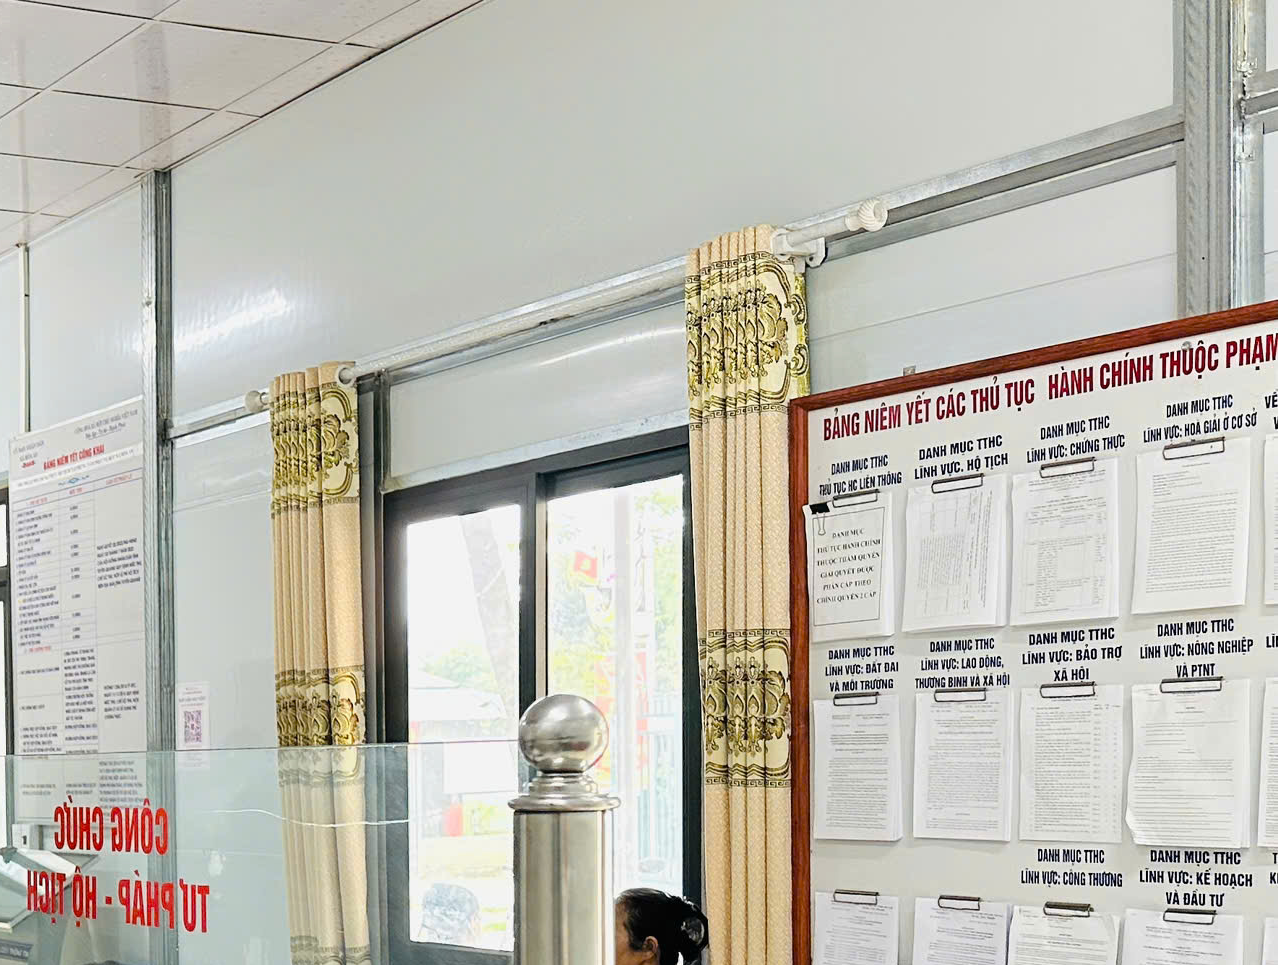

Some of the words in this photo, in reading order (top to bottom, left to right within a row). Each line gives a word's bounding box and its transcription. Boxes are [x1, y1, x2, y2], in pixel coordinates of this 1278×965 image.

[823, 408, 860, 441] BẢNG
[864, 402, 901, 433] NIÊM
[906, 391, 931, 426] YẾT
[936, 388, 966, 420] CÁC
[971, 376, 1000, 414] THỦ
[1005, 378, 1035, 412] TỤC
[1048, 366, 1094, 400] HÀNH
[1099, 352, 1154, 389] CHÍNH
[1159, 340, 1219, 379] THUỘC
[1166, 403, 1189, 418] DANH
[1191, 398, 1210, 415] MỤC
[1212, 394, 1233, 409] TTHC
[1040, 426, 1064, 441] DANH
[1066, 421, 1086, 437] MỤC
[1088, 415, 1110, 430] TTHC
[1143, 426, 1162, 443] LĨNH
[1203, 413, 1221, 434] GIẢI
[1223, 412, 1230, 430] Ở
[1232, 413, 1244, 429] CƠ
[1245, 407, 1258, 427] SỞ
[919, 445, 947, 460] DANH
[950, 439, 973, 455] MỤC
[978, 434, 1003, 449] TTHC
[1026, 447, 1047, 463] LĨNH
[1048, 443, 1068, 461] VỰC:
[1070, 437, 1100, 455] CHỨNG
[1102, 434, 1126, 452] THỰC
[831, 461, 850, 475] DANH
[852, 458, 868, 473] MỤC
[870, 454, 888, 469] TTHC
[914, 464, 938, 480] LĨNH
[967, 455, 981, 472] HỘ
[985, 453, 1008, 471] TỊCH
[848, 479, 857, 491] HC
[1029, 632, 1057, 646] DANH
[1060, 629, 1085, 645] MỤC
[1088, 627, 1115, 641] TTHC
[1157, 623, 1183, 637] DANH
[1185, 620, 1208, 637] MỤC
[1211, 618, 1234, 633] TTHC
[829, 649, 850, 660] DANH
[853, 647, 871, 659] MỤC
[874, 645, 894, 656] TTHC
[930, 641, 952, 653] DANH
[954, 639, 973, 653] MỤC
[975, 637, 995, 650] TTHC
[1022, 651, 1046, 665] LĨNH
[1048, 650, 1073, 666] VỰC:
[1075, 643, 1098, 661] BẢO
[1101, 645, 1123, 660] TRỢ
[1140, 645, 1161, 660] LĨNH
[1163, 643, 1185, 660] VỰC:
[1187, 640, 1216, 656] NÔNG
[1217, 637, 1254, 656] NGHIỆP
[825, 664, 843, 676] LĨNH
[845, 664, 864, 677] VỰC:
[884, 661, 899, 672] ĐAI
[921, 658, 939, 671] LĨNH
[941, 656, 959, 671] VỰC:
[961, 657, 976, 669] LAO
[1176, 663, 1189, 678] VÀ
[1191, 663, 1216, 677] PTNT
[948, 676, 968, 688] BINH
[969, 674, 981, 687] VÀ
[983, 673, 994, 687] XÃ
[996, 671, 1010, 687] HỘI
[1053, 667, 1068, 682] XÃ
[1071, 665, 1090, 683] HỘI
[829, 681, 840, 692] VÀ
[842, 678, 858, 691] MÔI
[1037, 848, 1060, 863] DANH
[1062, 849, 1082, 866] MỤC
[1084, 849, 1105, 864] TTHC
[1150, 850, 1180, 864] DANH
[1184, 850, 1210, 867] MỤC
[1213, 851, 1241, 865] TTHC
[1021, 867, 1040, 884] LĨNH
[1042, 870, 1061, 887] VỰC:
[1062, 867, 1086, 887] CÔNG
[1139, 867, 1164, 884] LĨNH
[1167, 870, 1193, 887] VỰC:
[1196, 867, 1211, 885] KẾ
[1214, 872, 1253, 890] HOẠCH
[1165, 890, 1180, 905] VÀ
[1183, 888, 1206, 907] ĐẦU
[1209, 893, 1225, 907] TƯ
